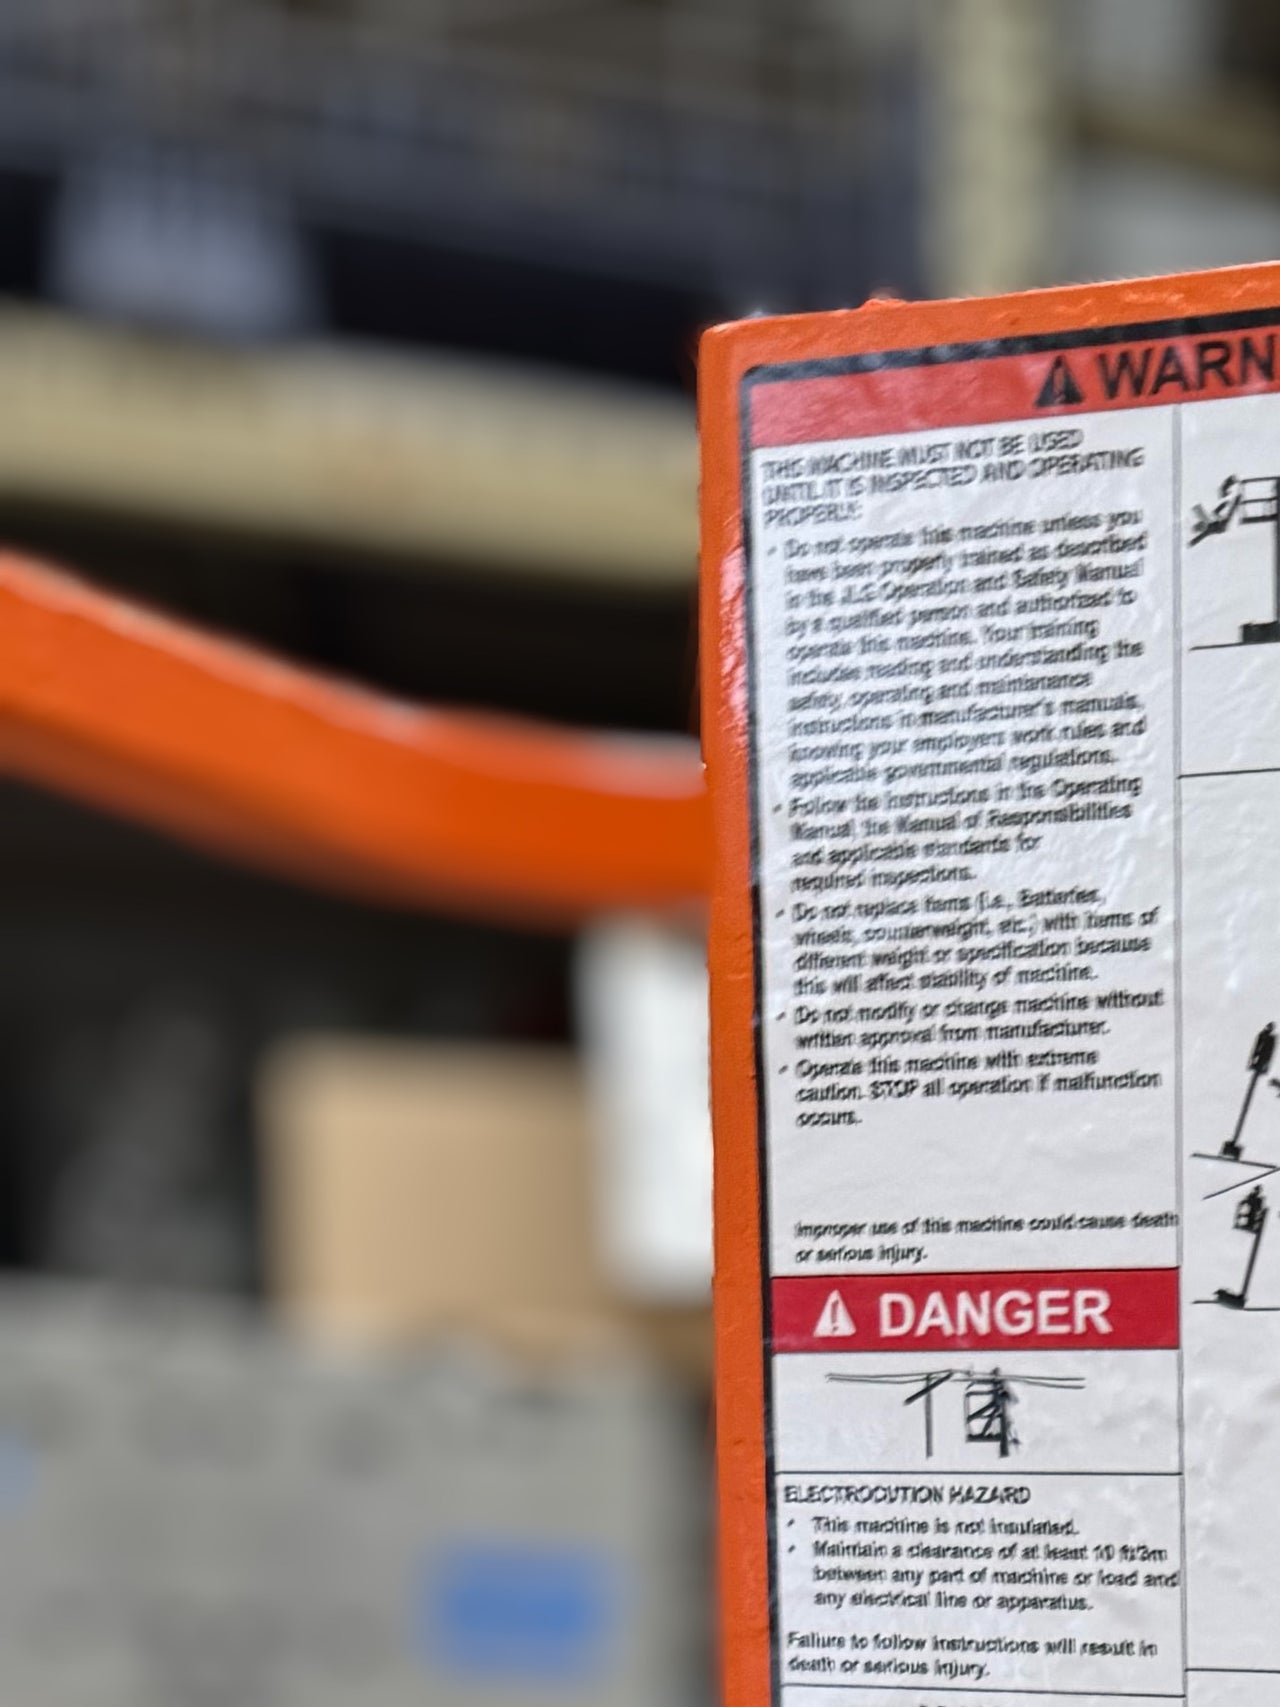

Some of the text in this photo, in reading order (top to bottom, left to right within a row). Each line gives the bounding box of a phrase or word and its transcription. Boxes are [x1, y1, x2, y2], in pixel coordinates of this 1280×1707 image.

[878, 1288, 1113, 1336] DANGER
[782, 1484, 1031, 1505] ELECTROCUTION HAZARD
[786, 1655, 990, 1681] death or serious injury.
